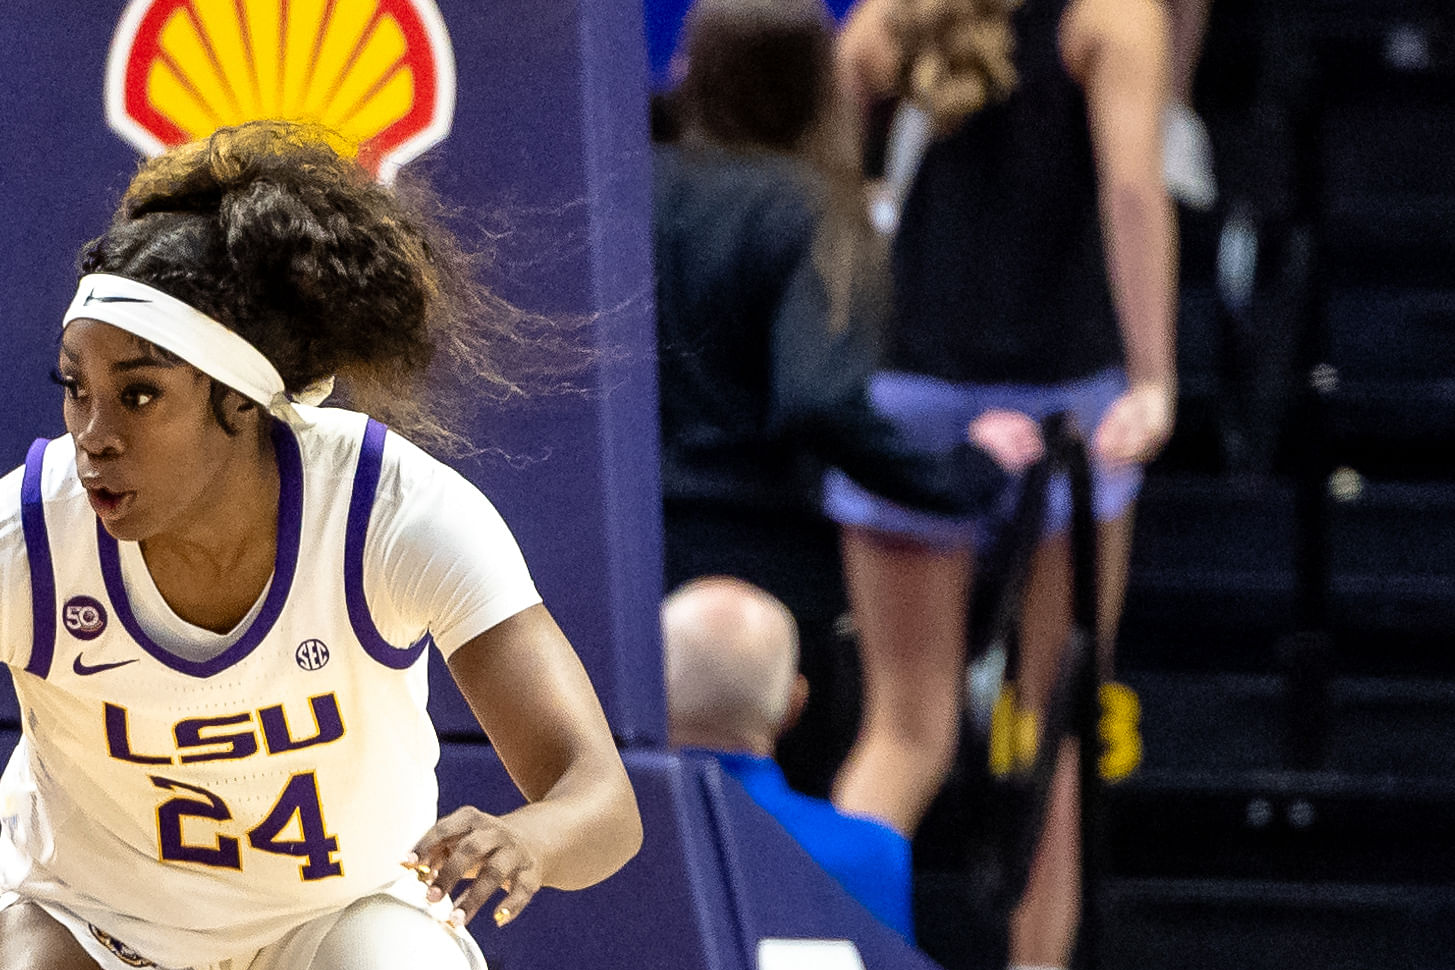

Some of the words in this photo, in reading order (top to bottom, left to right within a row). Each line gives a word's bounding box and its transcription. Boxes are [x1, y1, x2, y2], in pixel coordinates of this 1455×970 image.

[297, 639, 329, 671] SEC
[102, 690, 347, 766] LSU
[150, 769, 345, 882] 24
